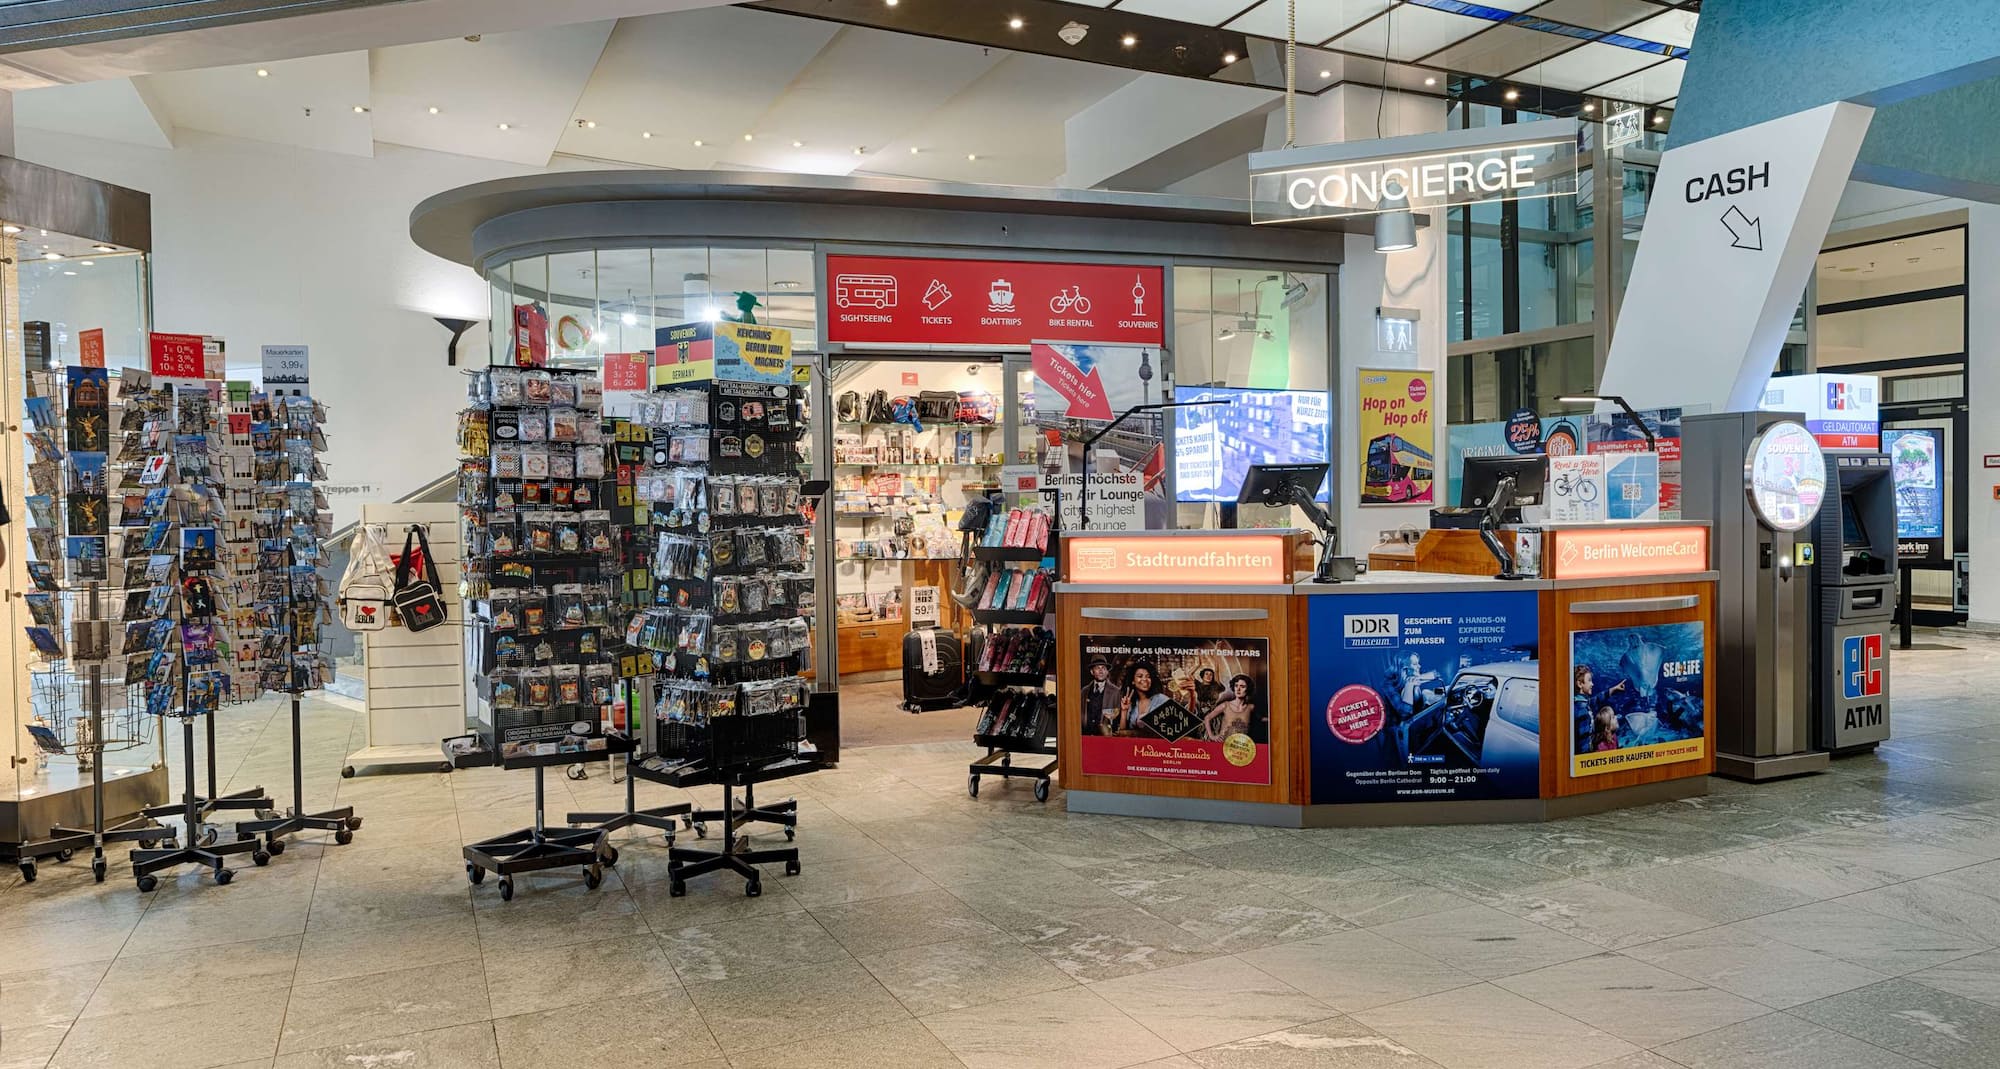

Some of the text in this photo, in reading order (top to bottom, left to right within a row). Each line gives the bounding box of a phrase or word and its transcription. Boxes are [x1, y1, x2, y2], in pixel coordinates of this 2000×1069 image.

[1287, 154, 1535, 211] CONCIERGE
[1685, 161, 1770, 204] CASH
[840, 313, 892, 324] SIGHTSEEING
[921, 315, 952, 325] TICKETS
[981, 316, 1022, 327] BOATTRIPS
[1049, 318, 1094, 328] BIKE RENTAL
[1118, 320, 1159, 330] SOUVENIRS
[160, 362, 170, 370] 10
[671, 368, 695, 380] GERMANY
[1049, 357, 1097, 400] Tickets hier
[1058, 378, 1090, 408] Tickets here
[1362, 397, 1406, 413] Hop on
[1384, 408, 1428, 428] Hop off
[1822, 421, 1876, 432] GELDAUTOMAT
[1842, 435, 1858, 447] ATM
[1045, 473, 1137, 485] Berlins höchste
[321, 486, 360, 494] Treppe
[1100, 488, 1144, 503] Lounge
[1096, 504, 1136, 518] highest
[1584, 540, 1698, 560] Berlin WelcomeCard
[1126, 552, 1272, 568] Stadtrundfahrten
[1352, 618, 1390, 634] DDR
[1404, 616, 1452, 625] GESCHICHTE
[1466, 616, 1506, 624] HANDS-ON
[1404, 627, 1422, 635] ZUM
[1458, 626, 1506, 634] EXPERIENCE
[1404, 636, 1445, 645] ANFASSEN
[1470, 636, 1504, 644] HISTORY
[1174, 648, 1198, 656] TANZE
[1663, 661, 1681, 678] SEA
[1338, 700, 1368, 714] TICKETS
[1338, 706, 1376, 724] AVAILABLE
[1844, 704, 1882, 730] ATM
[1350, 719, 1369, 730] HERE
[1134, 744, 1210, 760] Madame Tussauds
[1580, 758, 1608, 769] TICKETS
[1608, 755, 1624, 765] HIER
[1626, 751, 1654, 764] KAUFEN!
[1656, 750, 1666, 758] BUY
[1666, 747, 1686, 756] TICKETS
[1346, 770, 1375, 778] Gegenüber
